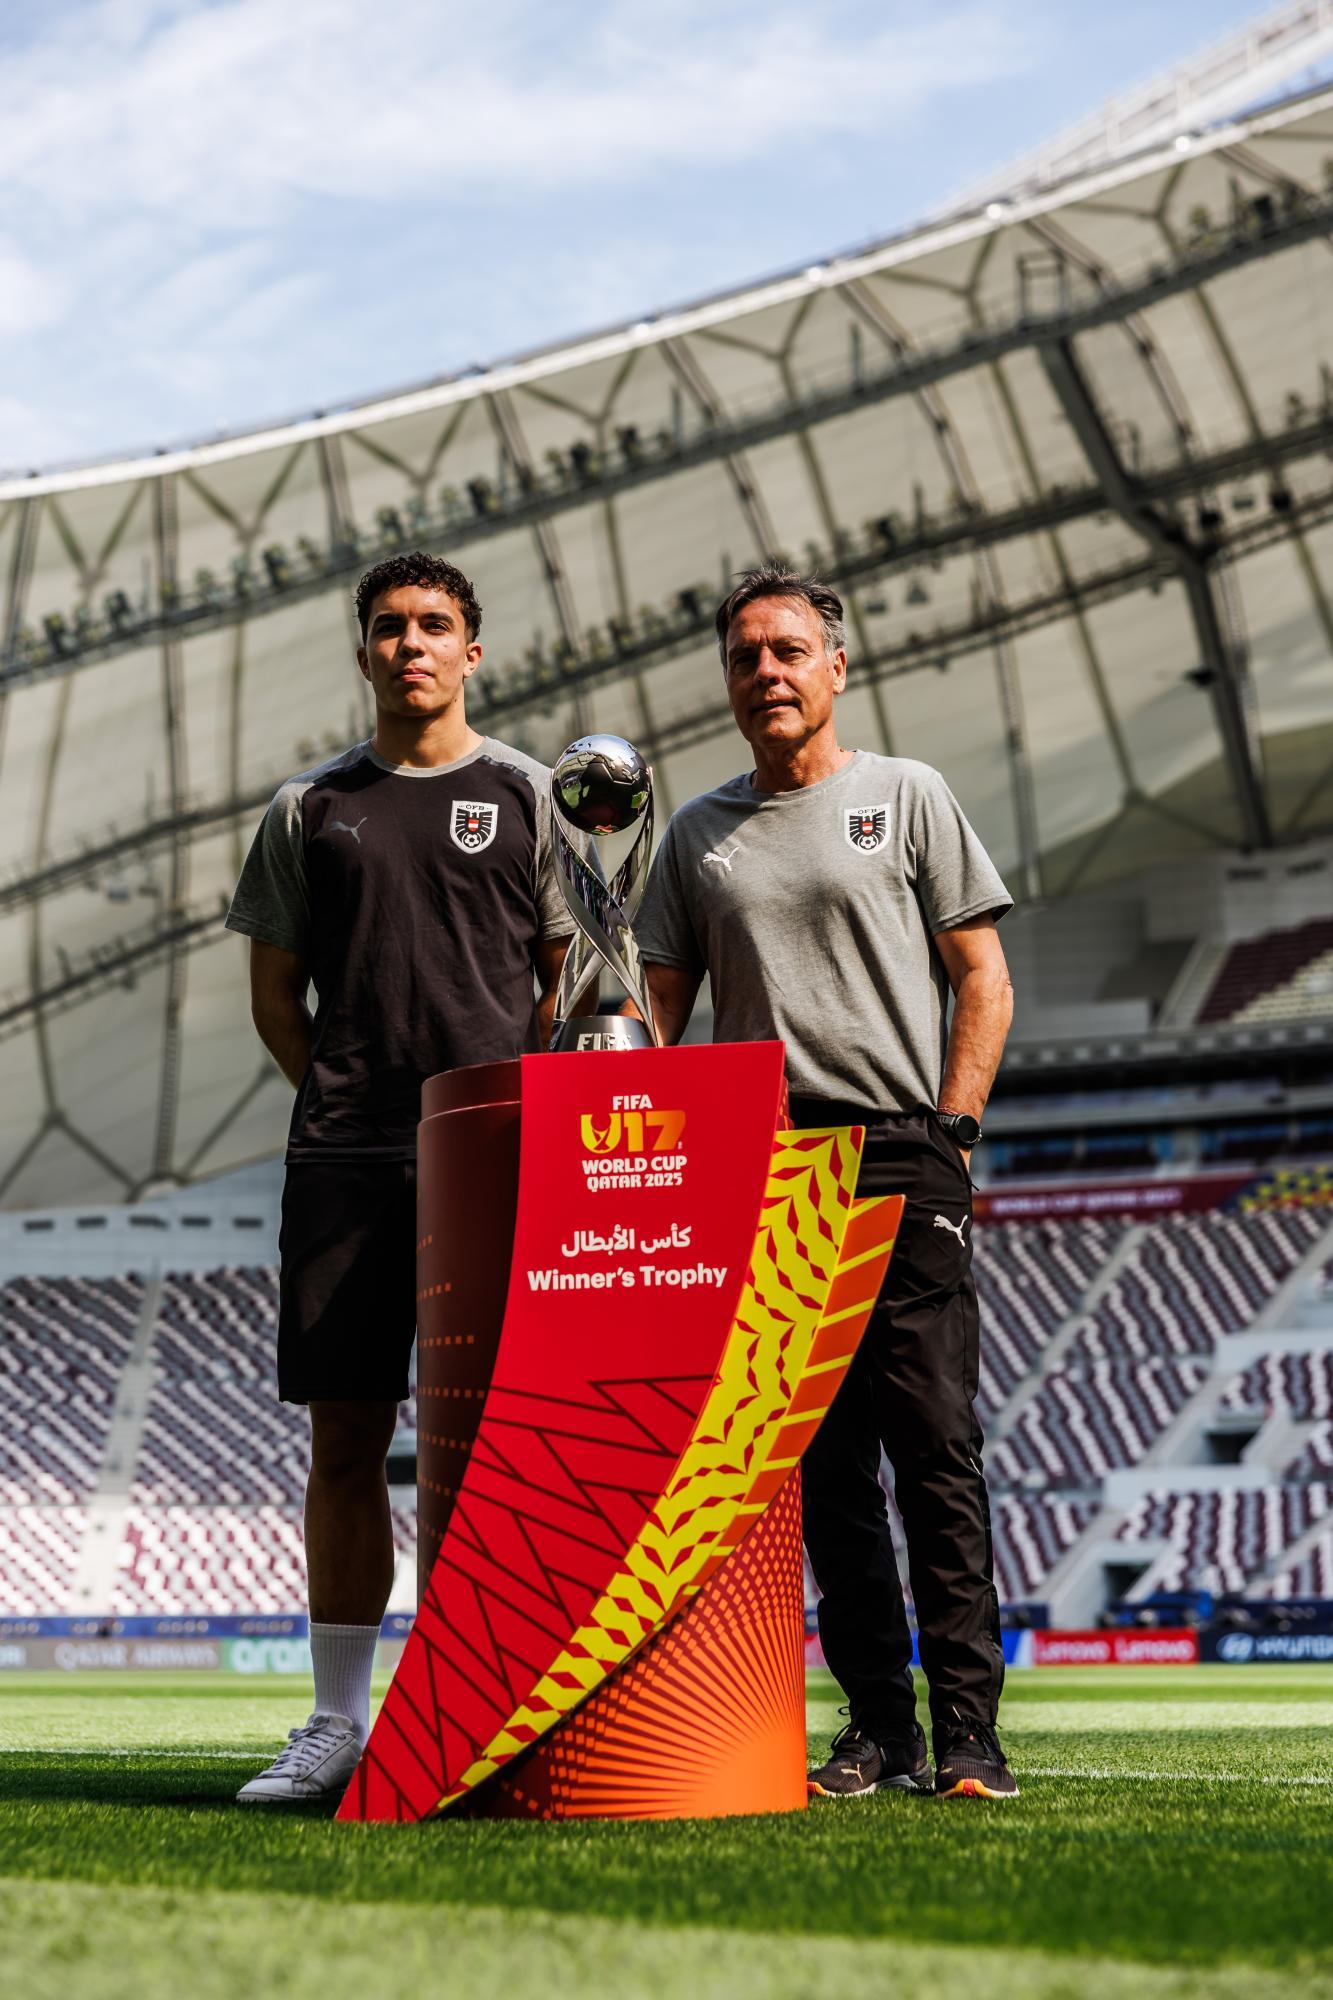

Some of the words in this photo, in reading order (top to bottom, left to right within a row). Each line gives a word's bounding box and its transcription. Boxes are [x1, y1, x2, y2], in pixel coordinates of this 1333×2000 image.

[577, 1032, 633, 1051] FIFA
[612, 1094, 654, 1111] FIFA
[580, 1109, 687, 1155] U17
[582, 1157, 648, 1175] WORLD
[650, 1155, 688, 1172] CUP
[586, 1174, 642, 1193] QATAR
[644, 1172, 683, 1188] 2025
[561, 1224, 636, 1258] الأبطال
[640, 1222, 693, 1255] كأس
[527, 1266, 635, 1291] Winner's
[639, 1262, 728, 1290] Trophy
[54, 1642, 128, 1671] QATAR
[132, 1642, 219, 1668] AIRWAYS
[1037, 1638, 1111, 1663] Lenovo
[1114, 1635, 1196, 1663] Lenovo
